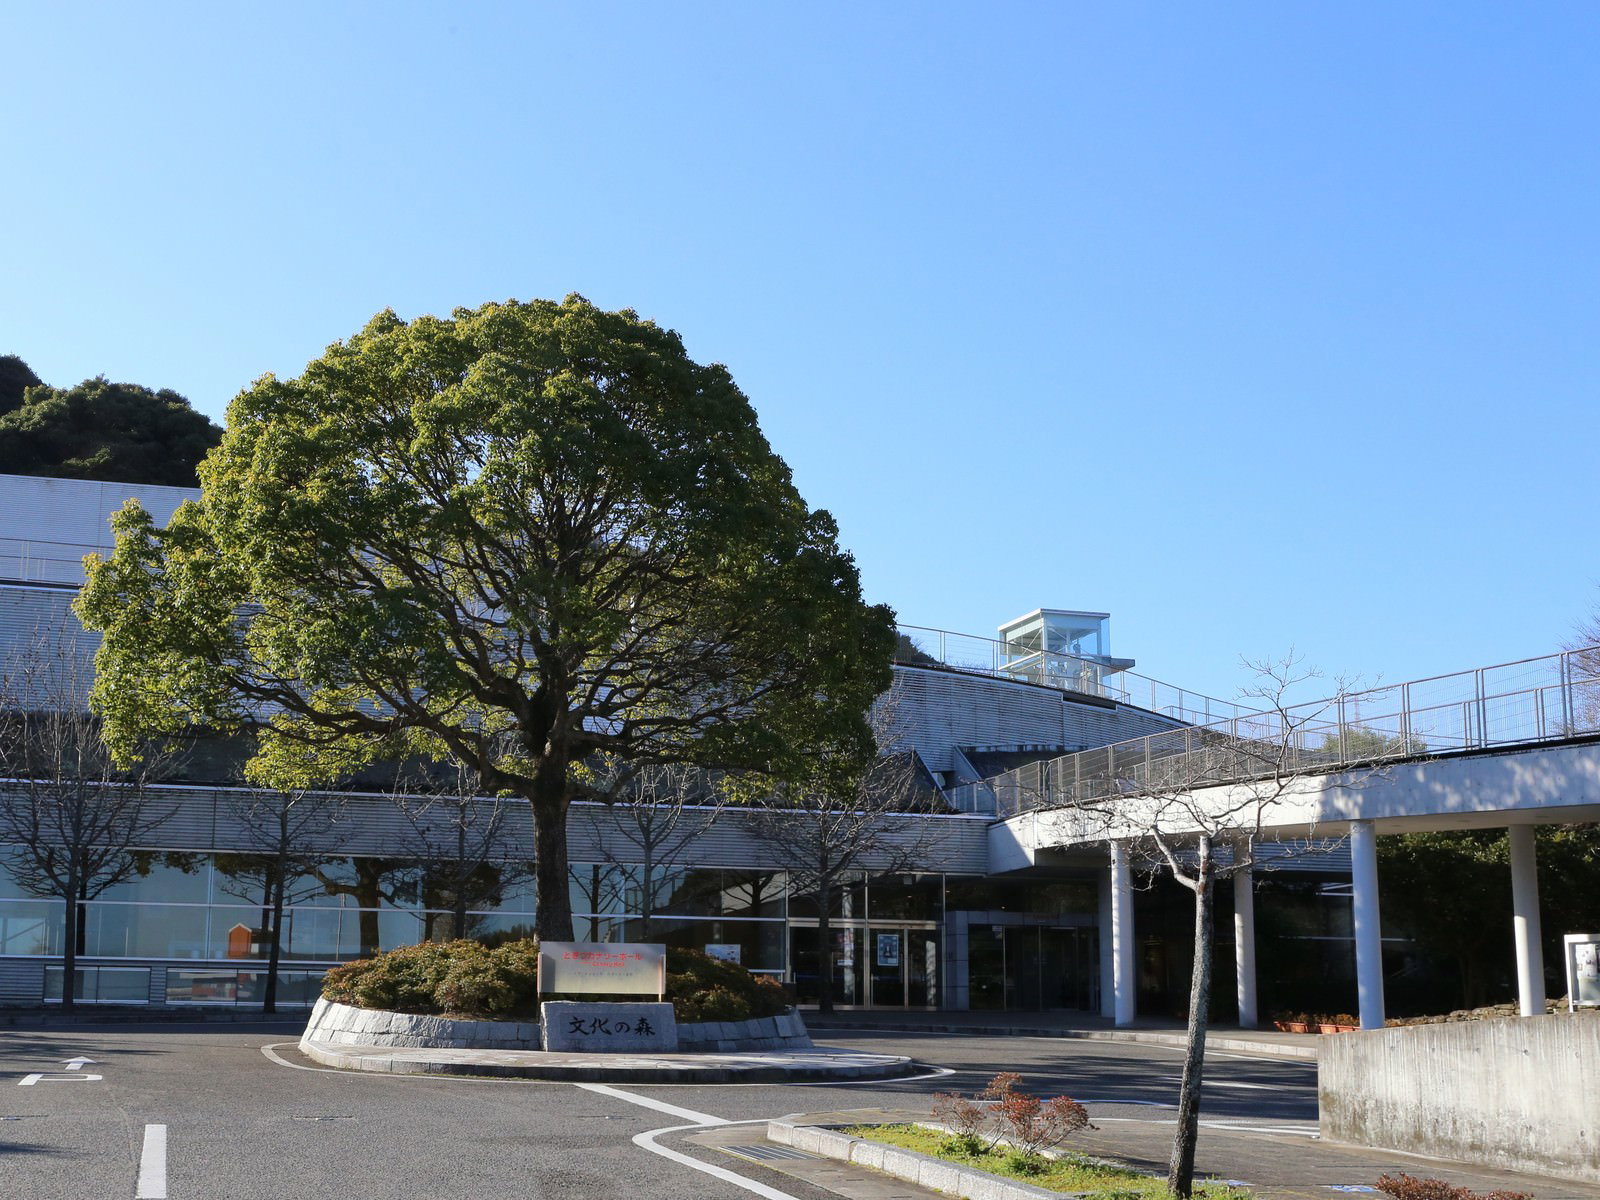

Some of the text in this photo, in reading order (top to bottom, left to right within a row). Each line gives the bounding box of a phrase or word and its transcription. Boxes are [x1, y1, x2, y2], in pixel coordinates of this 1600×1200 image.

[568, 1016, 656, 1036] 文化の森
[17, 1073, 103, 1086] P
